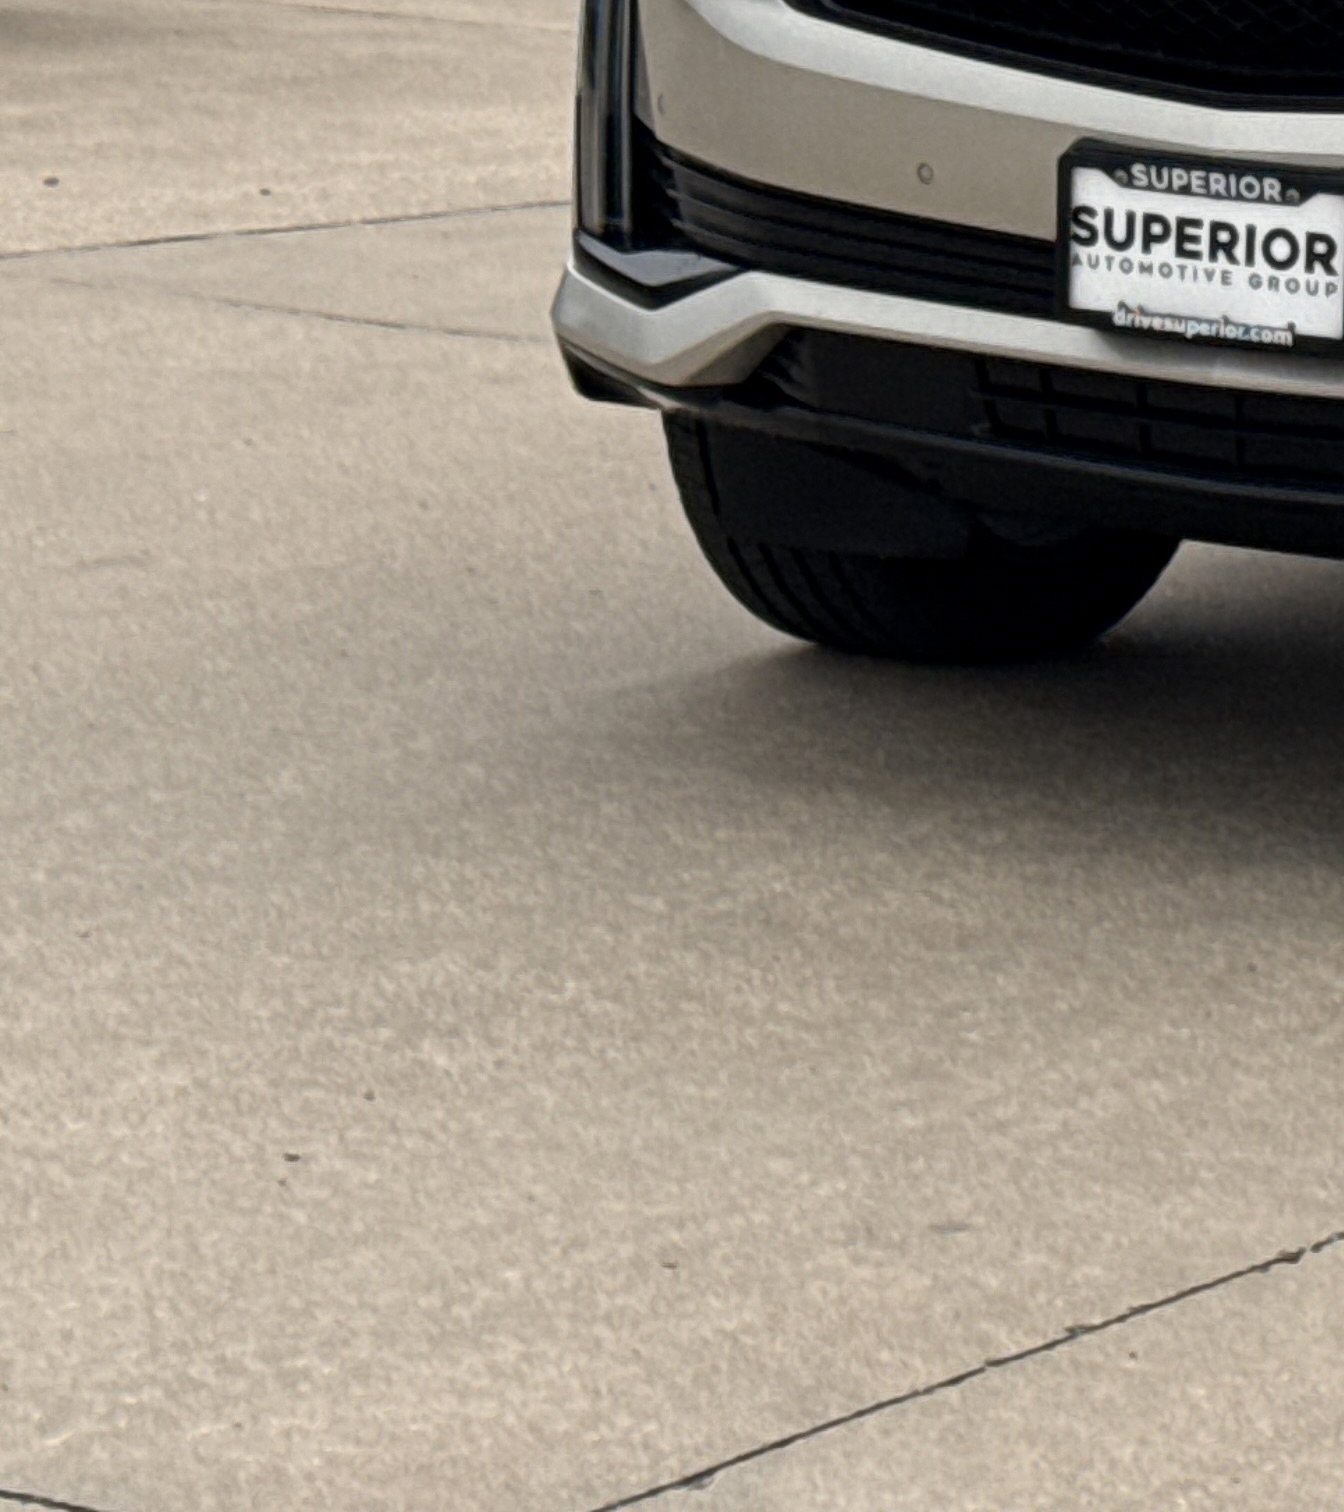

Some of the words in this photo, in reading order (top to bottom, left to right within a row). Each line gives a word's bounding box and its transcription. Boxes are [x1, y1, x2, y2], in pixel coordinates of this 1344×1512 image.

[1131, 162, 1283, 203] SUPERIOR
[1071, 205, 1339, 277] SUPERIOR
[1071, 252, 1234, 286] AUTOMOTIVE
[1248, 274, 1340, 299] GROUP
[1112, 303, 1294, 347] drivesuperior.com
